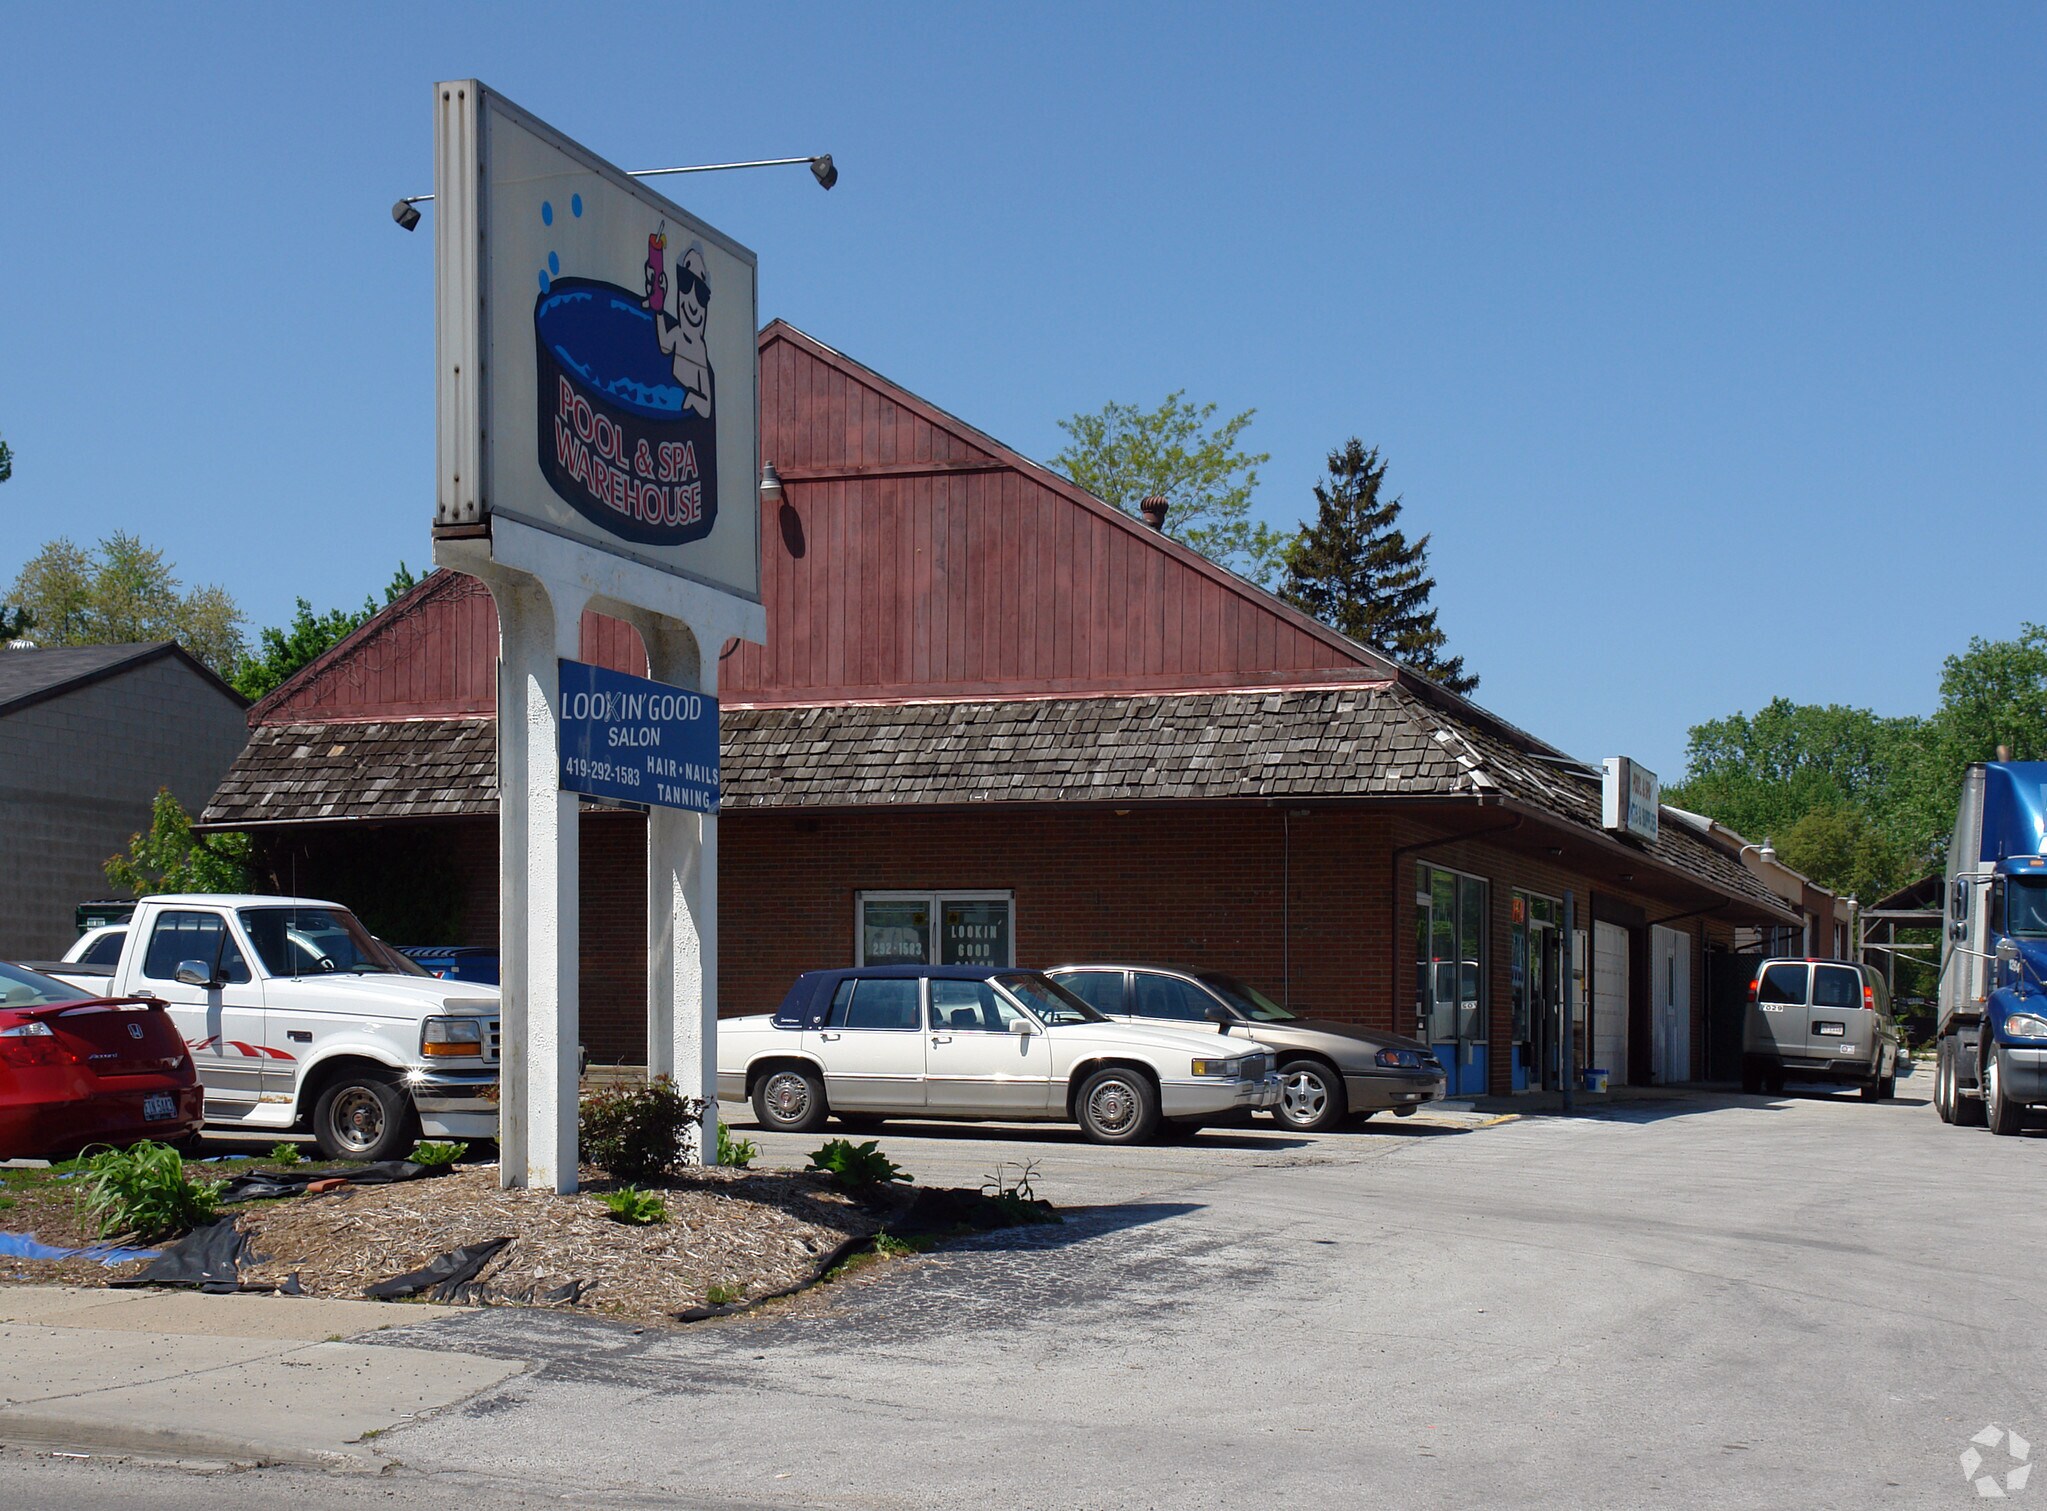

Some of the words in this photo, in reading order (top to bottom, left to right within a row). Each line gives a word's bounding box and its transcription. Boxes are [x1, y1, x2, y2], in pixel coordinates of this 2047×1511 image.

[559, 374, 629, 470] POOL
[634, 438, 656, 480] &
[658, 440, 699, 482] SPA
[554, 414, 701, 527] WAREHOUSE
[648, 695, 701, 721] GOOD
[608, 726, 660, 747] SALON
[566, 757, 640, 786] 419-292-1583
[647, 755, 677, 778] HAIR
[685, 762, 719, 786] NAILS
[657, 783, 710, 809] TANNING
[958, 943, 990, 957] GOOD
